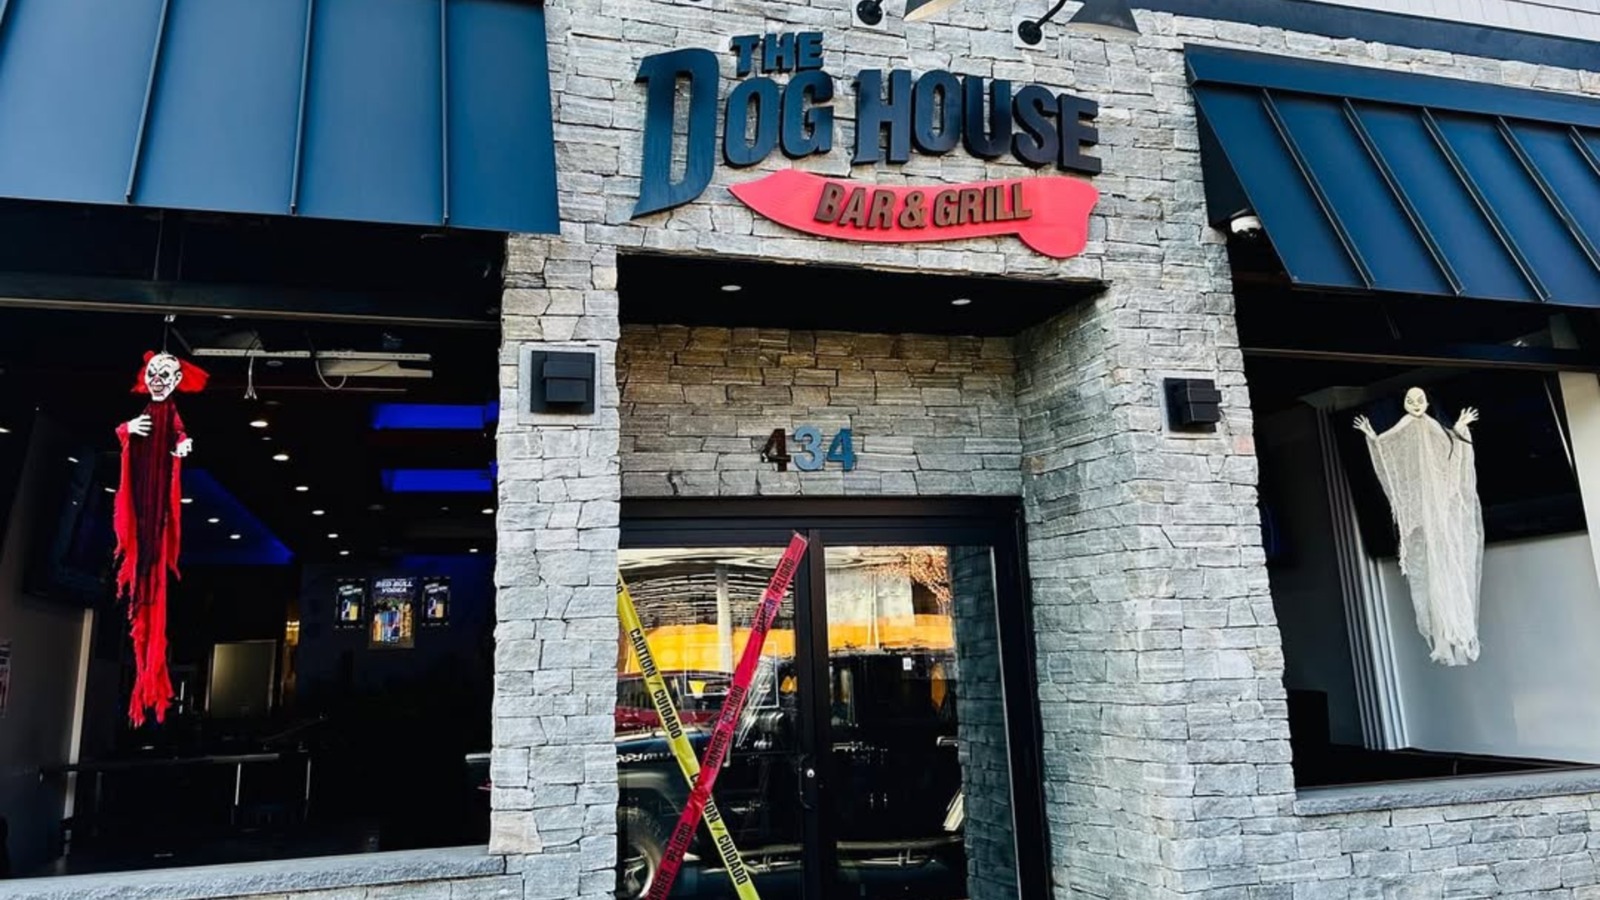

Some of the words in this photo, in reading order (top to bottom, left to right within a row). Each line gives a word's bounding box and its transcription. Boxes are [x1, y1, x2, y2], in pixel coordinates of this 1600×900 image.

[730, 32, 824, 77] THE
[630, 48, 834, 219] DOG
[851, 69, 1102, 175] HOUSE
[813, 182, 896, 229] BAR
[934, 182, 1033, 226] GRILL
[761, 426, 857, 472] 434
[630, 628, 658, 678] CAUTION
[654, 689, 682, 739] CUIDADO
[717, 834, 748, 885] CUIDADO
